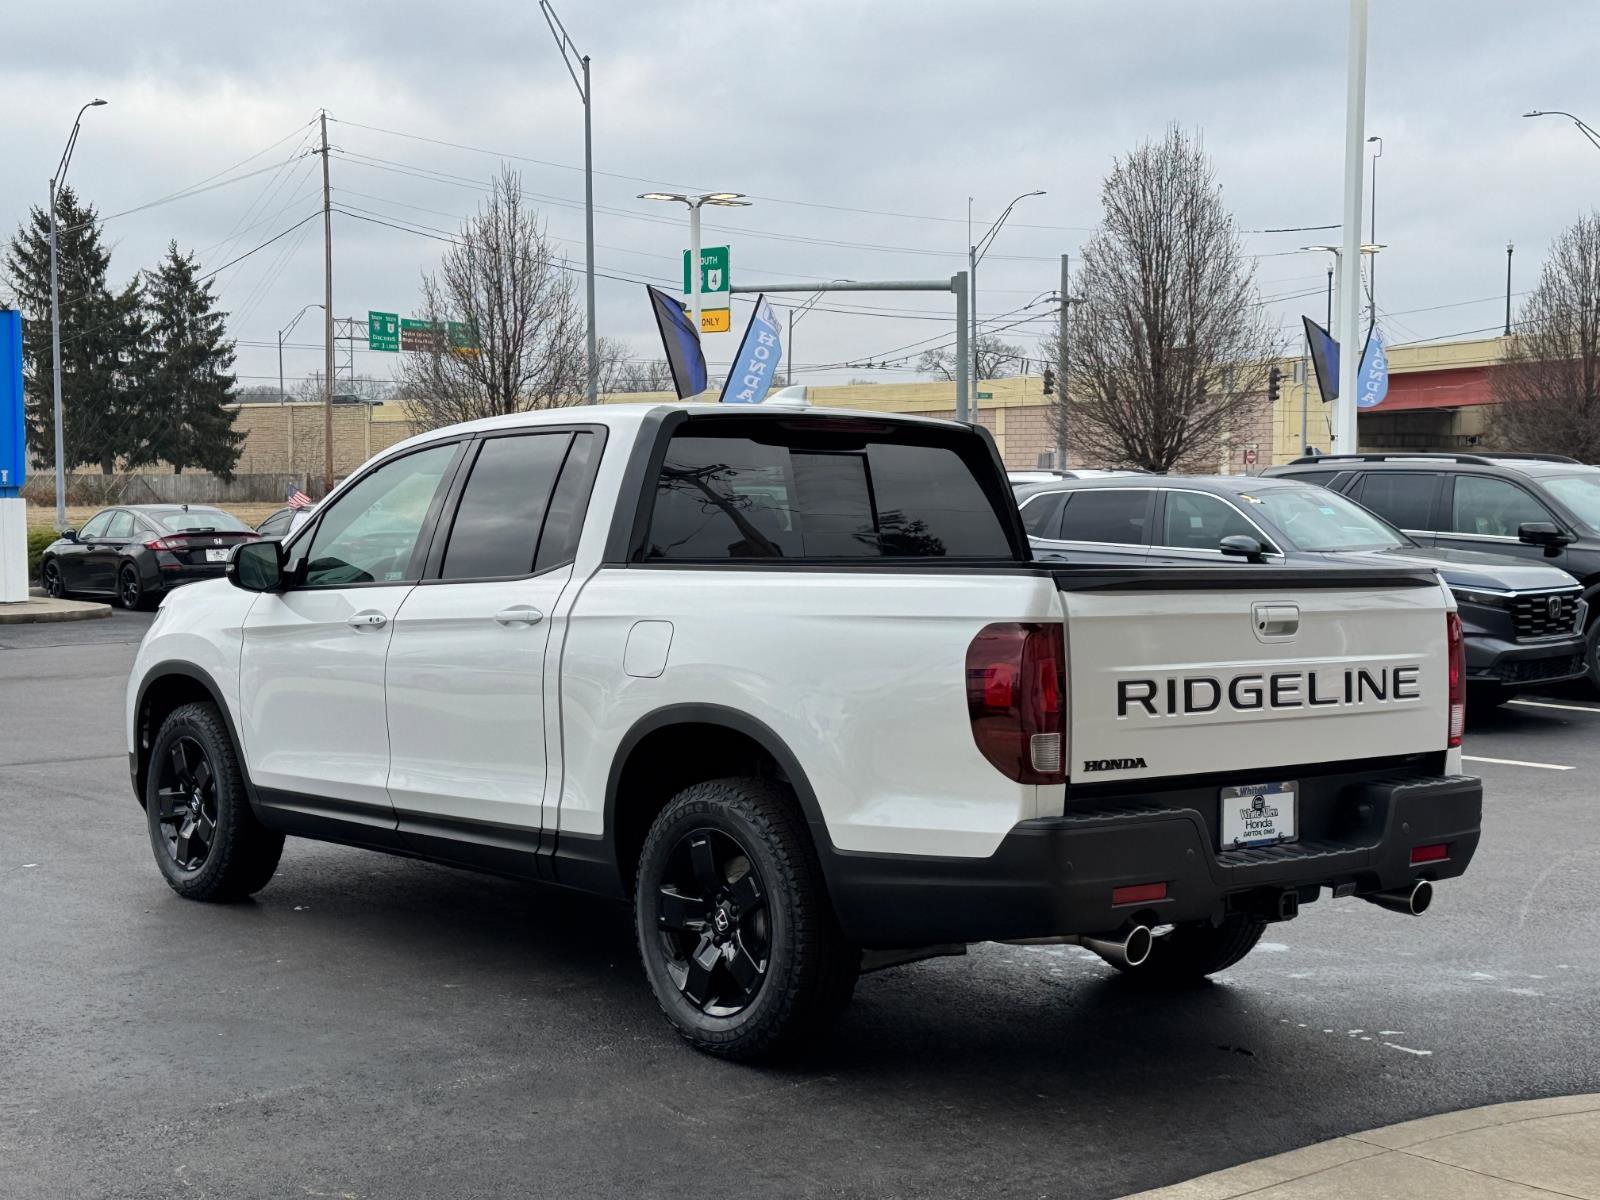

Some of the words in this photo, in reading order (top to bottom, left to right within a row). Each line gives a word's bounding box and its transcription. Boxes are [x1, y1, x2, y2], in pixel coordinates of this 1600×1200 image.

[700, 256, 718, 265] OUTH
[712, 273, 717, 285] 4
[701, 318, 720, 327] ONLY
[1117, 664, 1421, 720] RIDGELINE
[1083, 757, 1148, 772] HONDA
[1245, 819, 1272, 829] Honda
